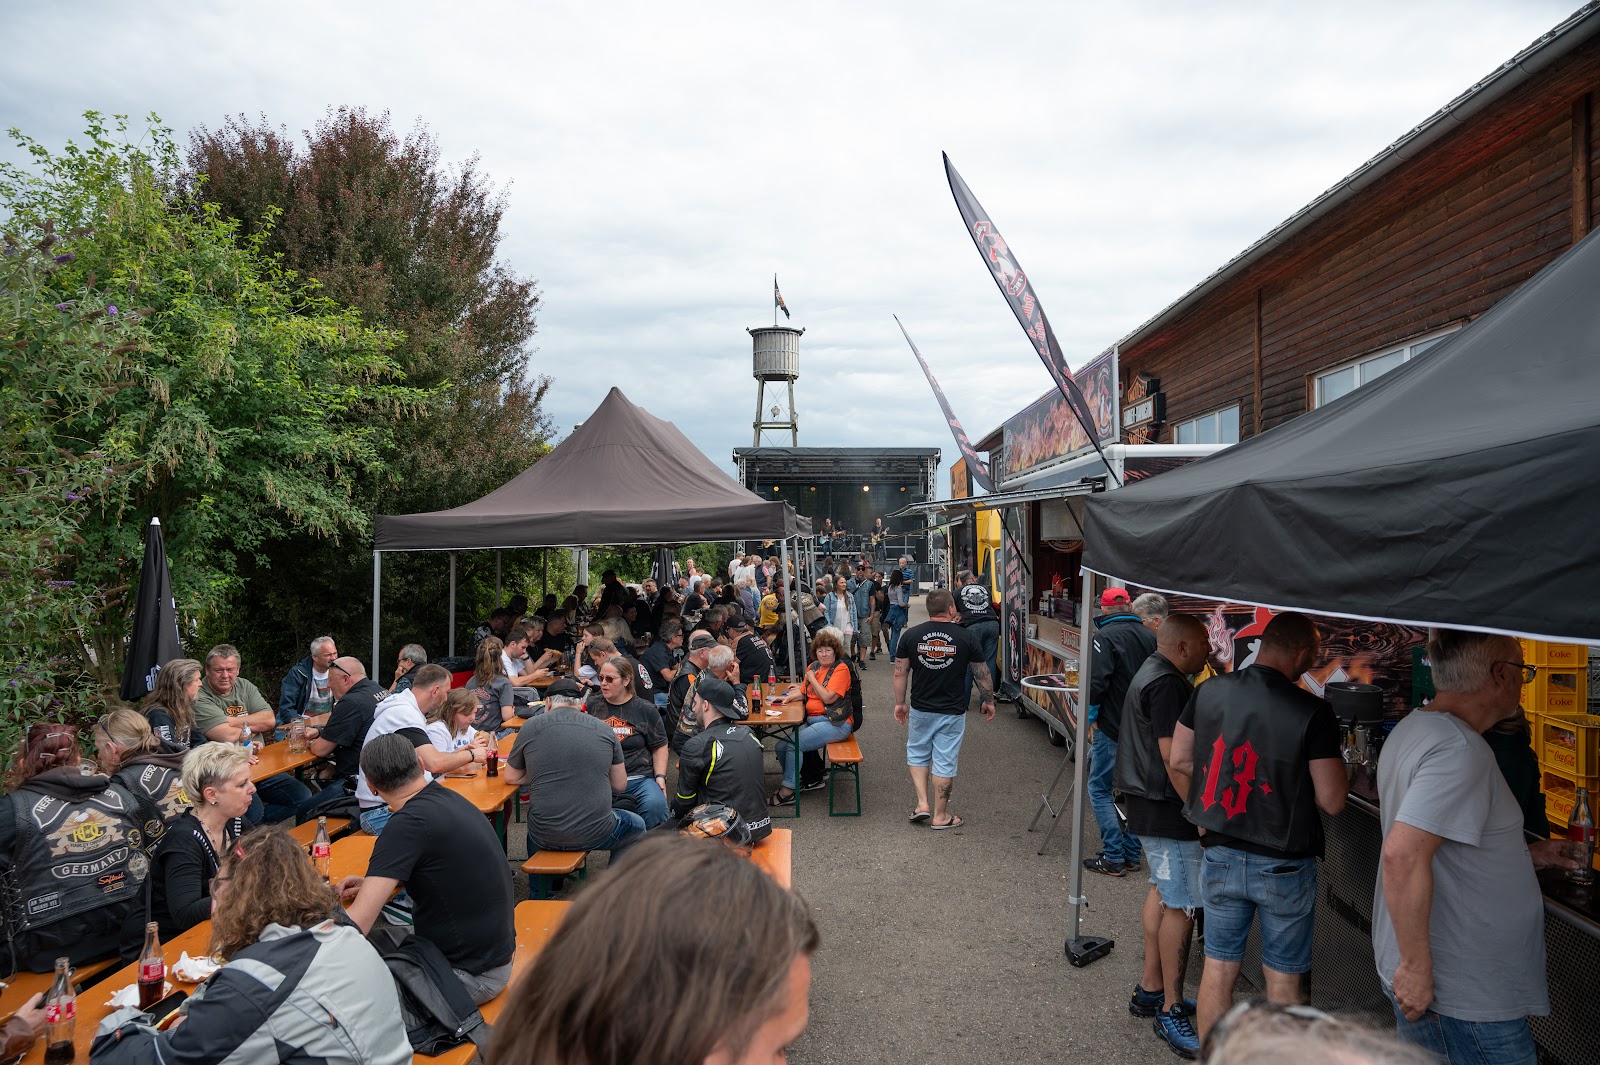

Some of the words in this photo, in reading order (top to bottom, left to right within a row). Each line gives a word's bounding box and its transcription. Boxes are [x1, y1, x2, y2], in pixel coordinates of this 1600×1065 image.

[1549, 650, 1571, 658] Coke
[1549, 697, 1573, 706] Coke
[1554, 750, 1575, 767] Coca-Cola
[1200, 732, 1260, 821] 13
[61, 850, 123, 876] GERMANY
